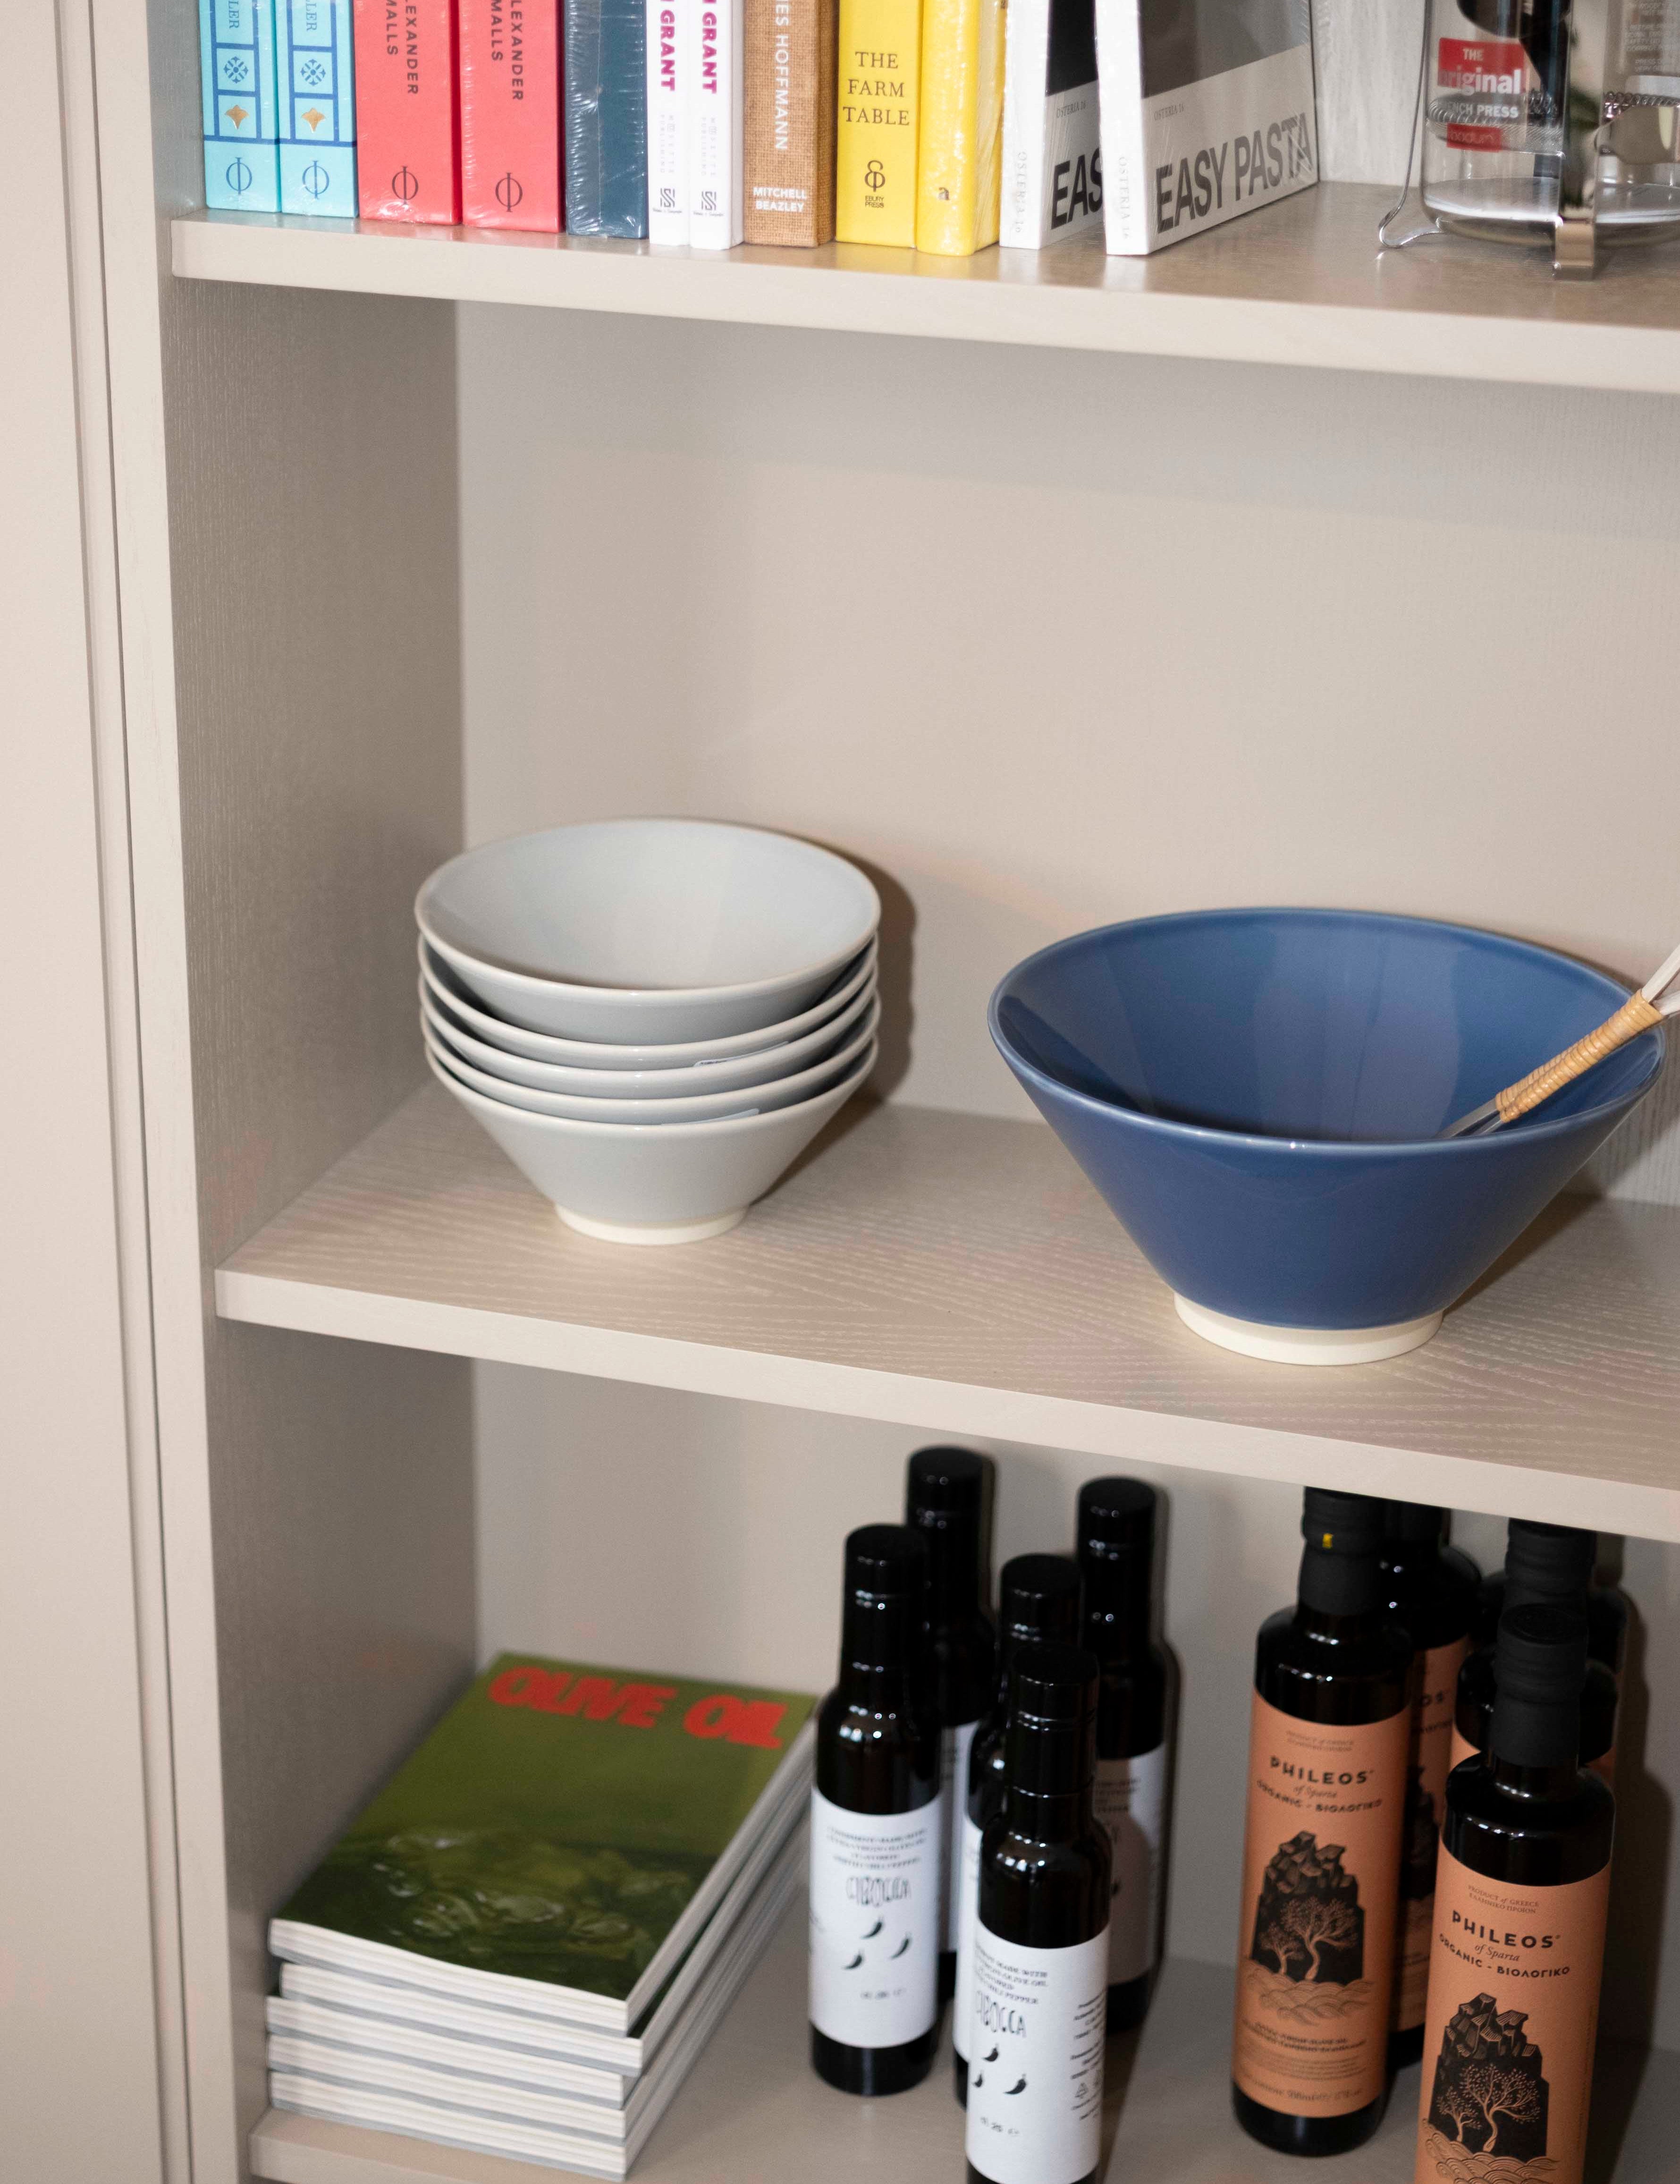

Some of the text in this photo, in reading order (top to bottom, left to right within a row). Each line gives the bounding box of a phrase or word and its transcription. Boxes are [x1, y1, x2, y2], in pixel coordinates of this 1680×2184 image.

[306, 0, 317, 31] LER
[660, 9, 675, 92] GRANT
[702, 12, 718, 94] GRANT
[855, 51, 899, 69] THE
[1463, 48, 1484, 62] THE
[775, 0, 789, 150] ES HOFFMANN
[847, 78, 905, 98] FARM
[843, 106, 910, 126] TABLE
[1476, 104, 1519, 119] PRESS
[1156, 112, 1314, 234] EASY PASTA
[752, 187, 807, 199] MITCHELL
[756, 200, 804, 213] BEAZLEY
[1270, 1755, 1368, 1785] PHILEOS
[1452, 1909, 1553, 1948] PHILEOS
[1439, 1933, 1483, 1968] ORGANIC
[1475, 1944, 1520, 1962] of Sparta
